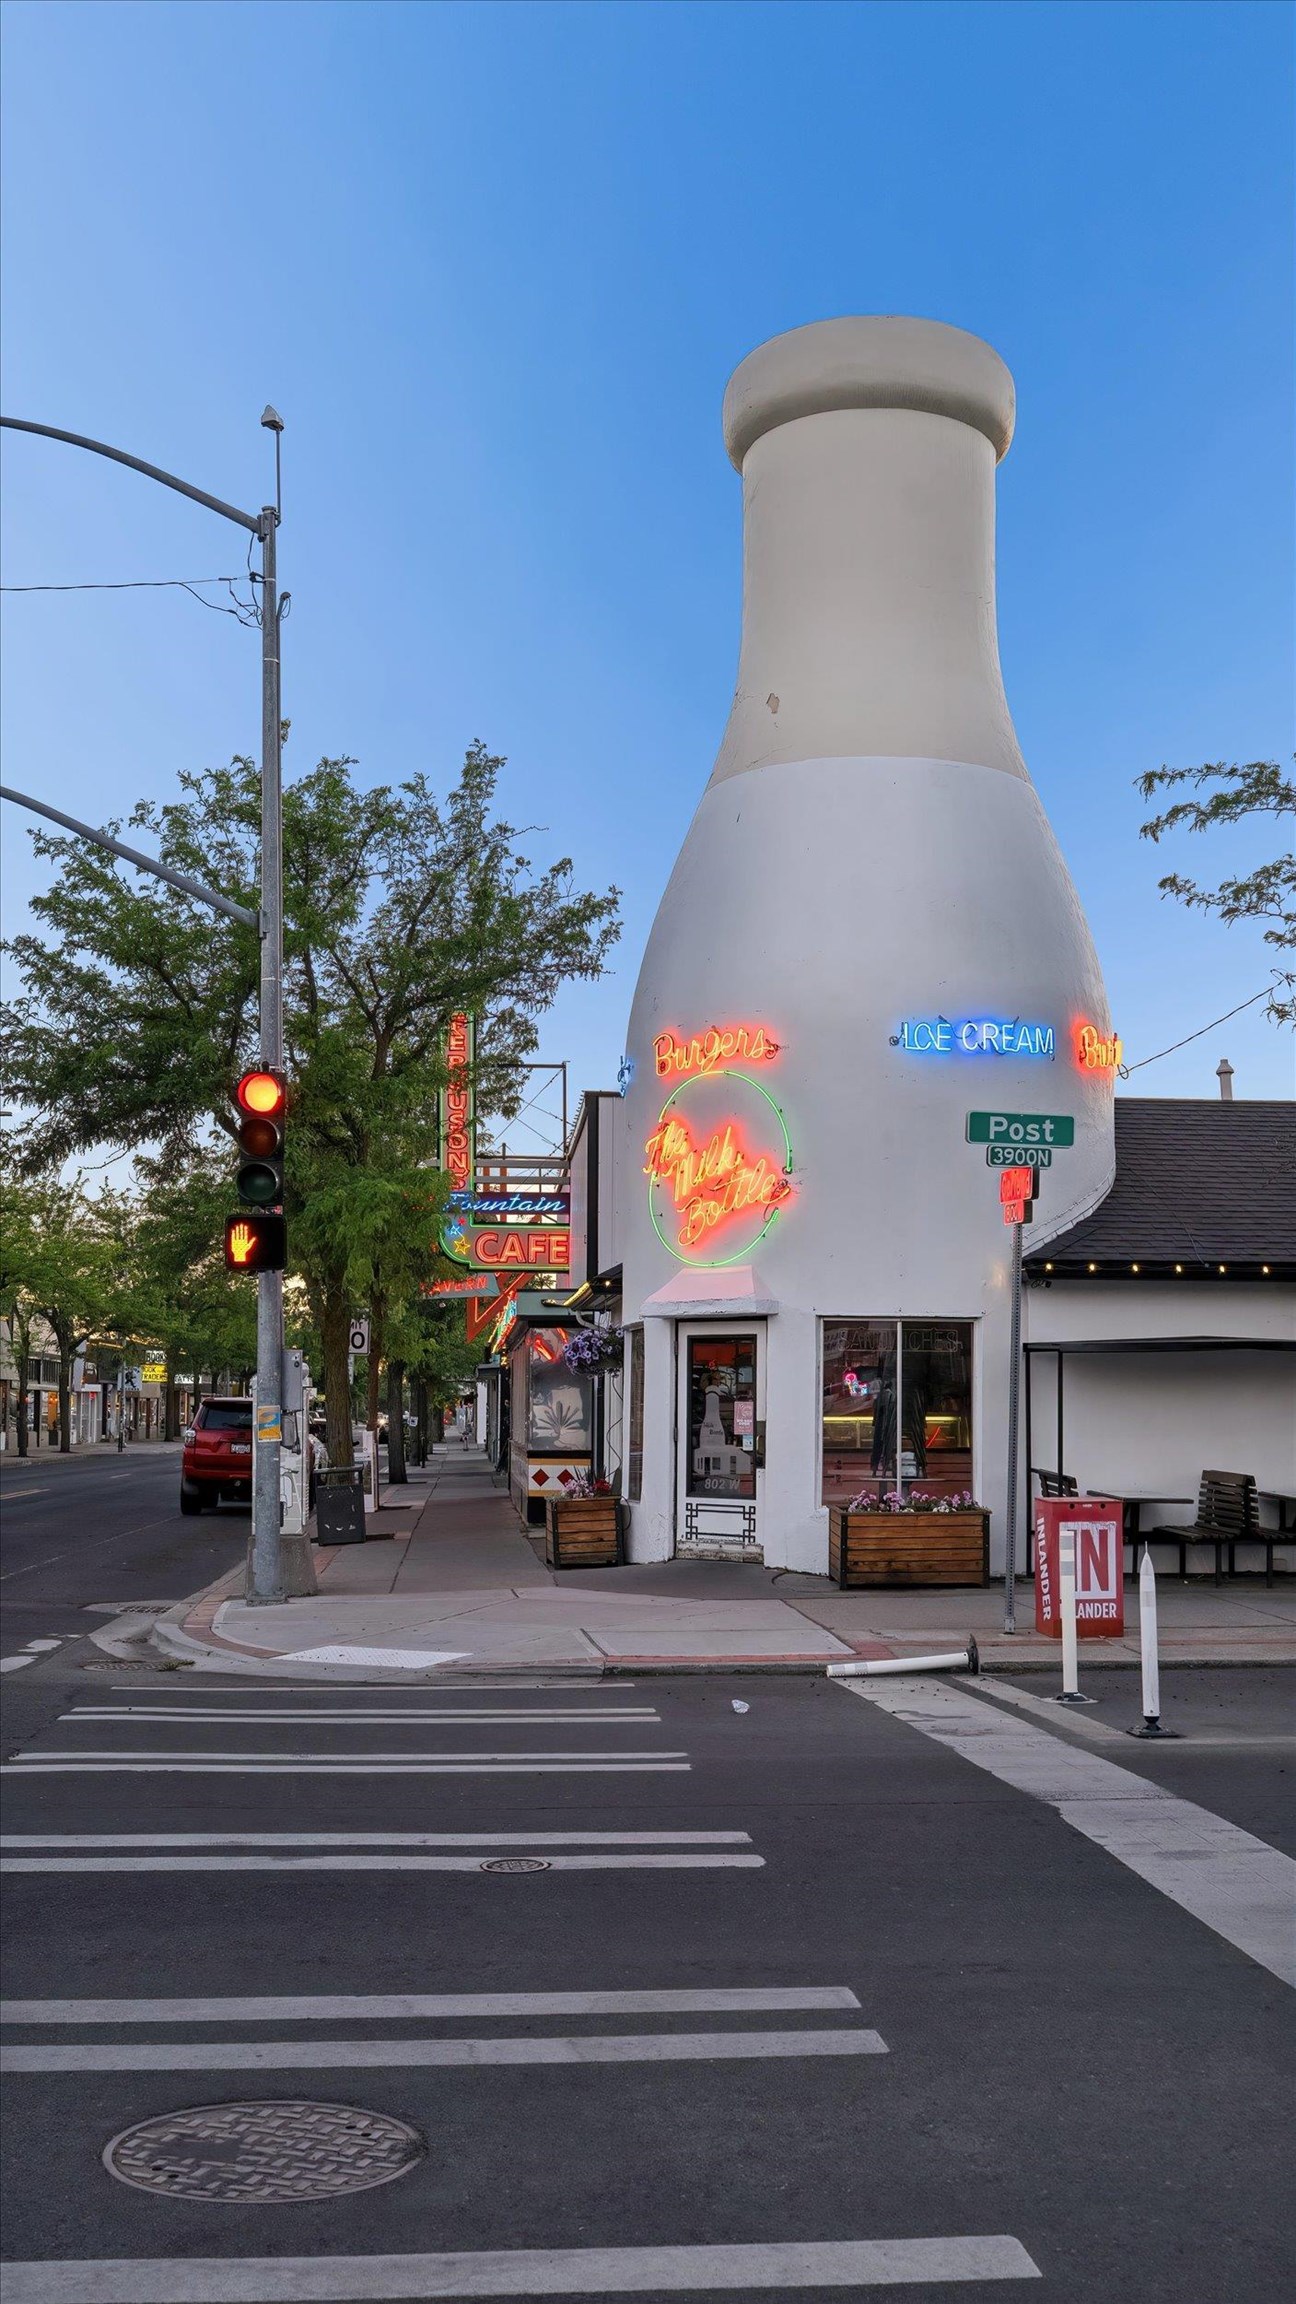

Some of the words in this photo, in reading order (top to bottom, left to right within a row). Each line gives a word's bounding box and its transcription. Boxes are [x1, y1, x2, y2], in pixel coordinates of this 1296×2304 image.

[652, 1027, 774, 1077] Burgers
[903, 1022, 951, 1051] ICE
[962, 1022, 1053, 1054] CREAM
[989, 1116, 1055, 1142] Post
[642, 1120, 688, 1174] The
[993, 1149, 1049, 1166] 3900N
[663, 1126, 742, 1202] Milk
[676, 1158, 791, 1246] Bottle
[475, 1232, 569, 1264] CAFE
[350, 1331, 366, 1350] 0
[705, 1479, 725, 1489] 802
[1037, 1517, 1051, 1620] INLANDER
[1076, 1602, 1117, 1619] ANDER
